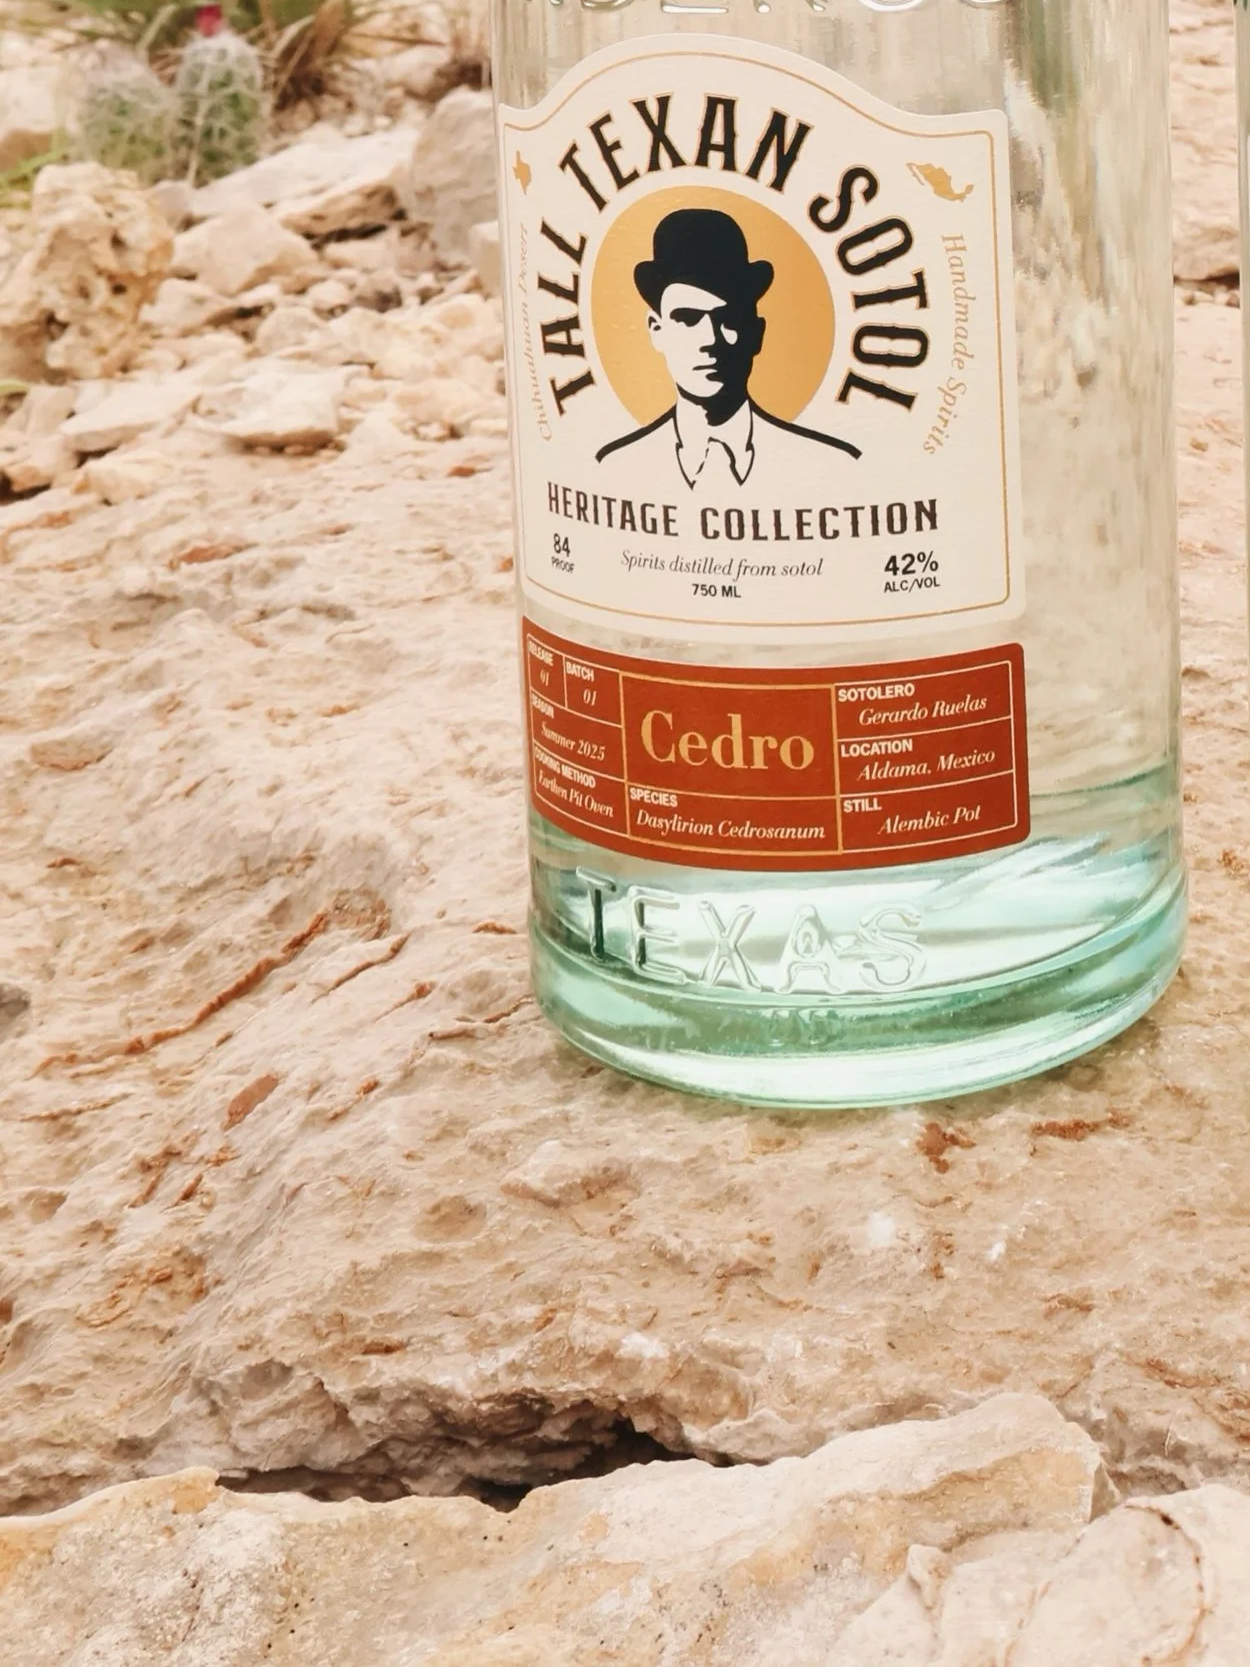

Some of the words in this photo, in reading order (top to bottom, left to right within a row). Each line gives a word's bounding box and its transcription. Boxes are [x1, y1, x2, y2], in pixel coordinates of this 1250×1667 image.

[558, 91, 814, 213] TEXAN
[808, 164, 931, 412] SOTOL
[941, 234, 977, 370] Handmade
[537, 215, 597, 416] TALL
[923, 375, 968, 455] Spirits
[548, 481, 679, 537] HERITAGE
[700, 498, 938, 541] COLLECTION
[553, 532, 571, 557] 84
[551, 556, 575, 574] PROOF
[621, 549, 665, 572] Spirits
[669, 555, 733, 576] distilled
[733, 558, 776, 582] from
[781, 558, 824, 576] sotol
[884, 551, 939, 576] 42%
[692, 583, 717, 597] 750
[722, 585, 741, 598] ML
[884, 576, 940, 593] ALC/VOL
[566, 661, 595, 682] BATCH
[583, 689, 597, 707] 01
[838, 683, 915, 702] SOTOLERO
[859, 702, 928, 726] Gerardo
[932, 694, 987, 718] Ruelas
[541, 721, 575, 752] Summer
[577, 739, 606, 761] 2025
[641, 710, 814, 770] Cedro
[841, 739, 913, 758] LOCATION
[936, 749, 995, 772] Mexico
[562, 765, 596, 789] METHOD
[584, 796, 614, 818] Oven
[630, 788, 677, 808] SPECIES
[843, 797, 882, 813] STILL
[636, 810, 714, 836] Dasylirion
[718, 820, 825, 839] Cedrosanum
[877, 811, 950, 834] Alembic
[575, 865, 930, 996] TEXAS
